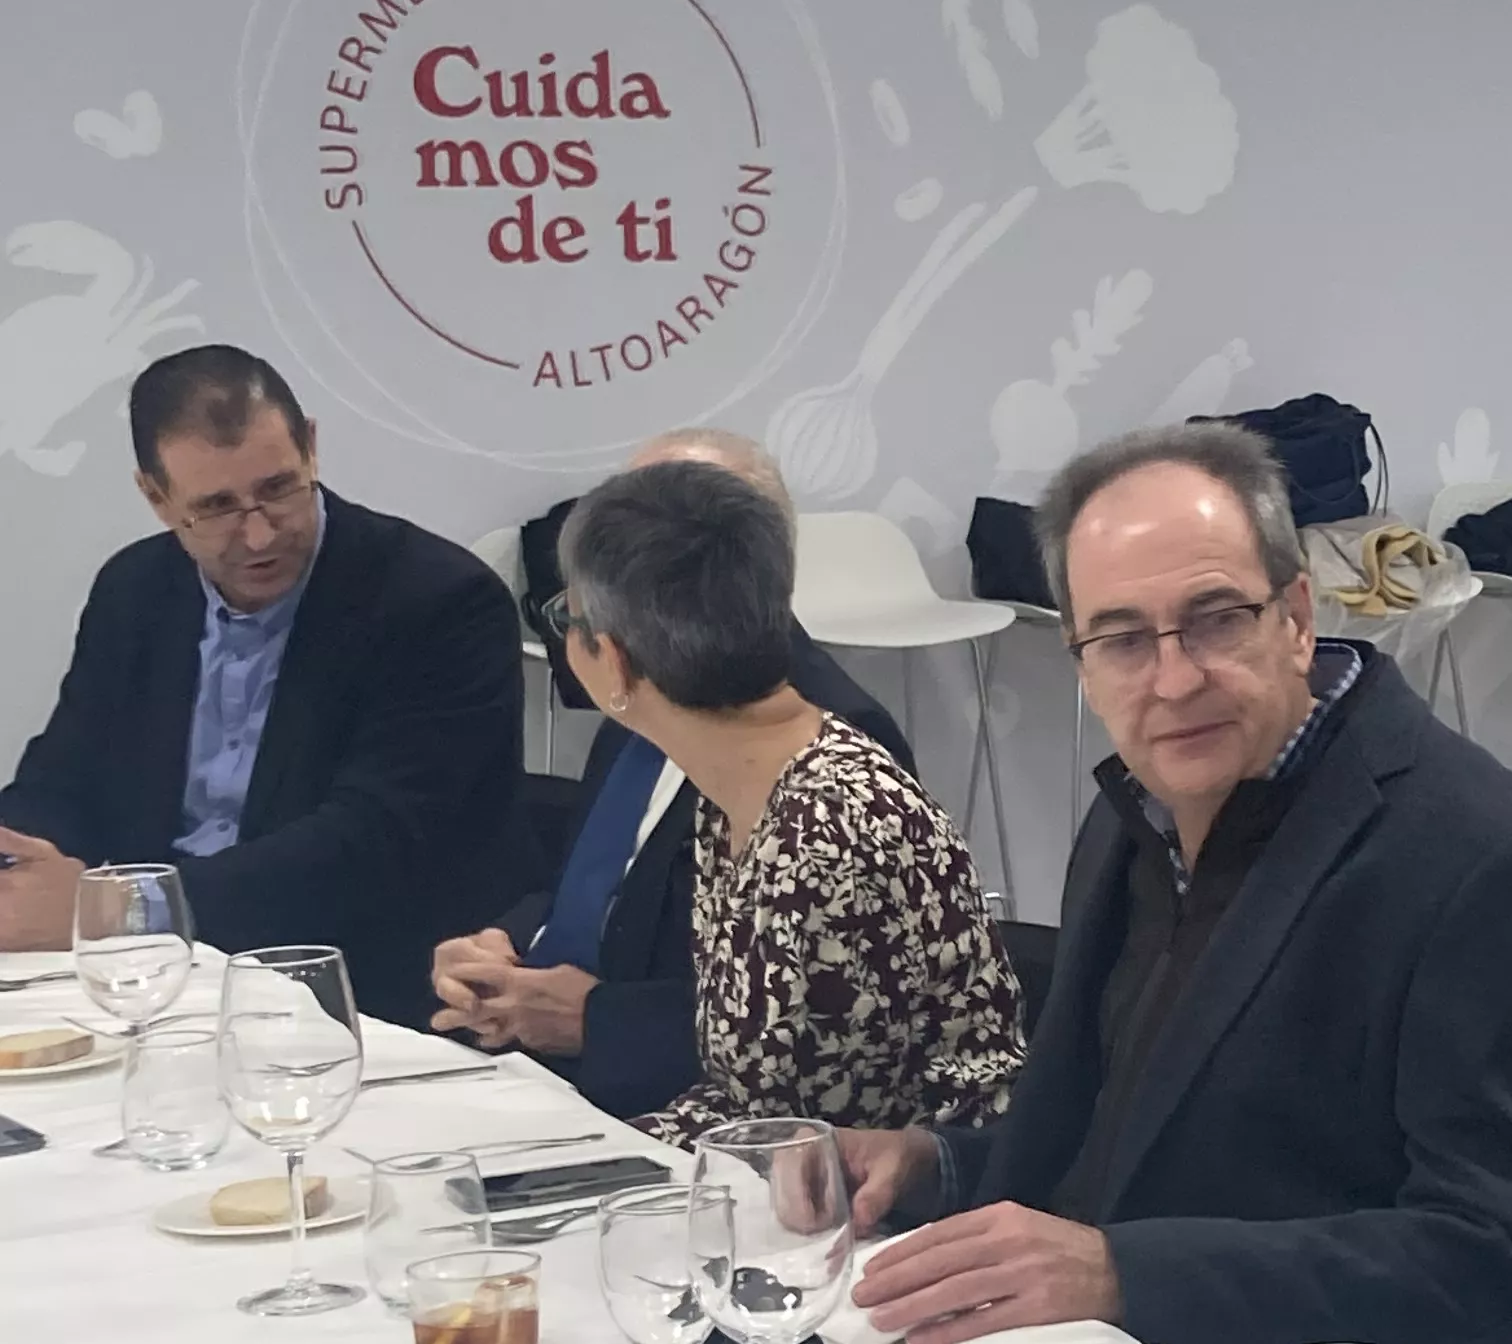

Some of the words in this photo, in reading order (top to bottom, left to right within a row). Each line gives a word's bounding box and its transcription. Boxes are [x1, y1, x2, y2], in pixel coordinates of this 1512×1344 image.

[413, 45, 671, 119] Cuida
[415, 138, 598, 190] mos
[488, 194, 588, 263] de
[616, 197, 678, 262] ti
[533, 164, 773, 388] ALTOARAGÓN
